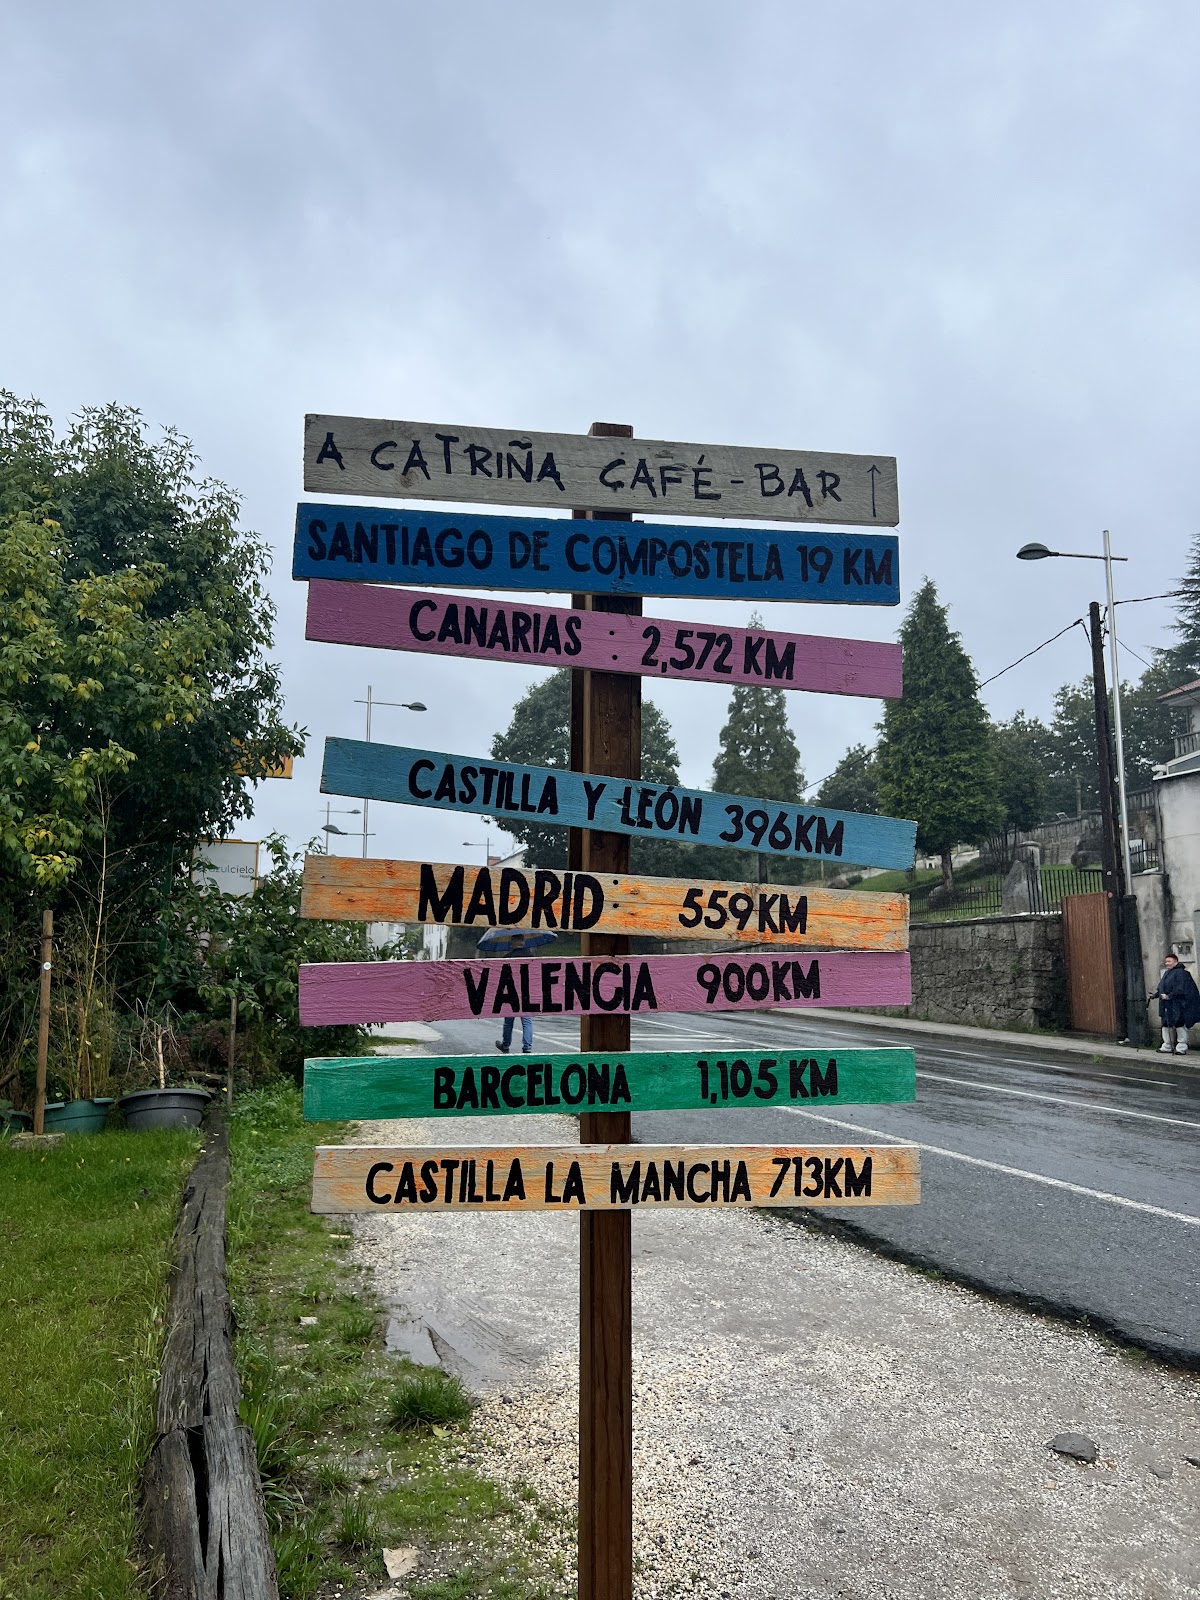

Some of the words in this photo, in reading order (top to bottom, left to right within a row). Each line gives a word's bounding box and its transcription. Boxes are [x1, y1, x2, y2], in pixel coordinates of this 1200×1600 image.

[316, 432, 345, 470] A
[370, 433, 566, 491] CATRIÑA
[754, 463, 842, 508] BAR
[308, 519, 493, 570] SANTIAGO
[508, 530, 550, 571] DE
[564, 533, 785, 583] COMPOSTELA
[796, 545, 833, 583] 19
[843, 548, 893, 586] KM
[408, 600, 582, 656] CANARIAS
[641, 625, 733, 674] 2,572
[743, 636, 796, 680] KM
[408, 759, 559, 815] CASTILLA
[583, 780, 607, 821] Y
[620, 785, 703, 835] LEÓN
[418, 863, 604, 930] MADRID
[463, 962, 658, 1016] VALENCIA
[433, 1063, 632, 1110] BARCELONA
[697, 1059, 778, 1105] 1,105
[789, 1058, 838, 1099] KM
[365, 1158, 526, 1204] CASTILLA
[544, 1161, 586, 1205] LA
[610, 1160, 752, 1204] MANCHA
